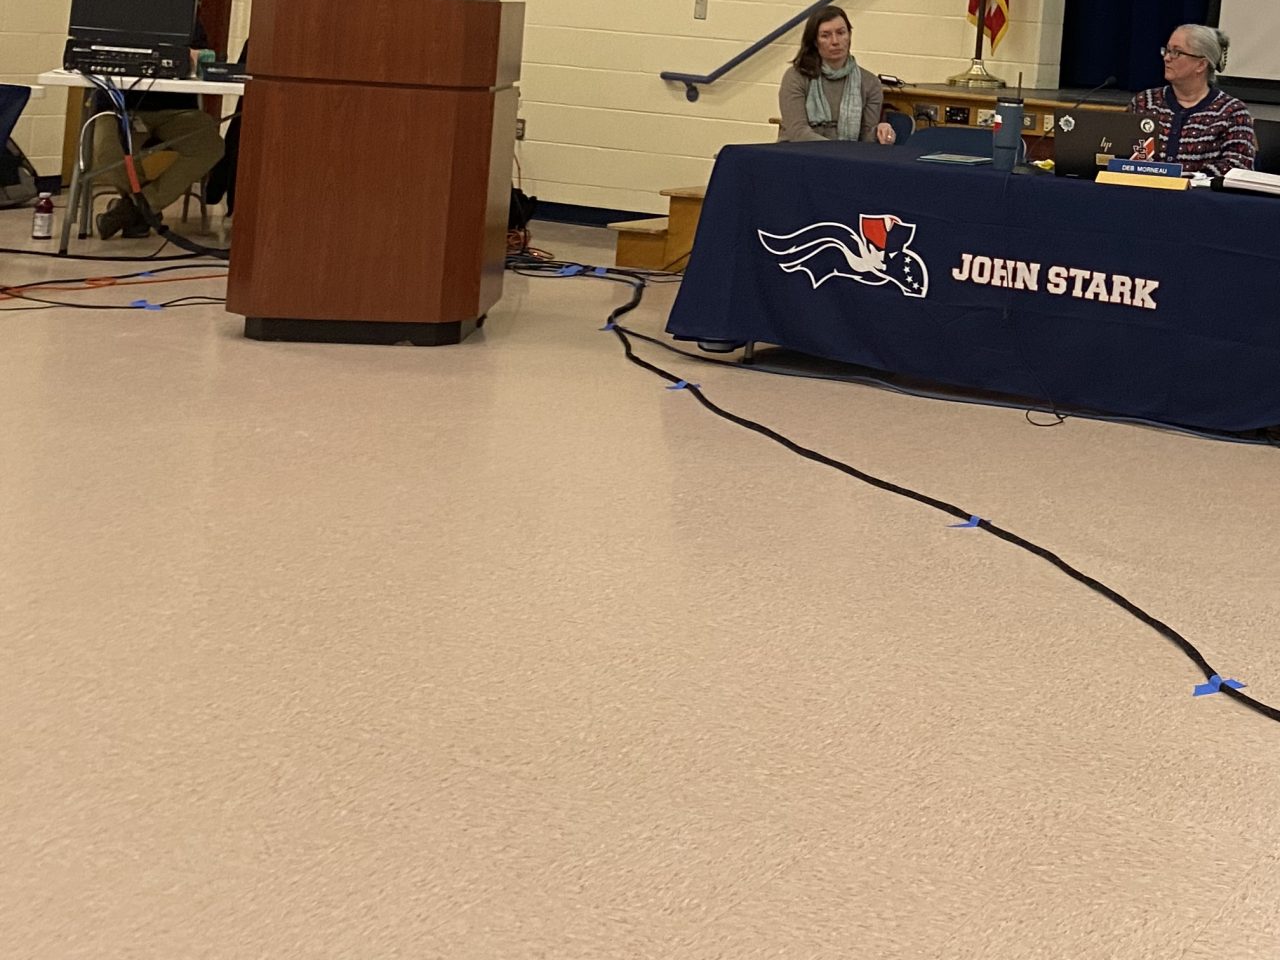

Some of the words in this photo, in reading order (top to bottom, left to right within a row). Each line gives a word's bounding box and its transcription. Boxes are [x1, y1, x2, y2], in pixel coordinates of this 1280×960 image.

[1121, 164, 1135, 172] DEB
[1137, 165, 1168, 174] MORNEAU
[951, 252, 1041, 291] JOHN
[1046, 264, 1160, 310] STARK
